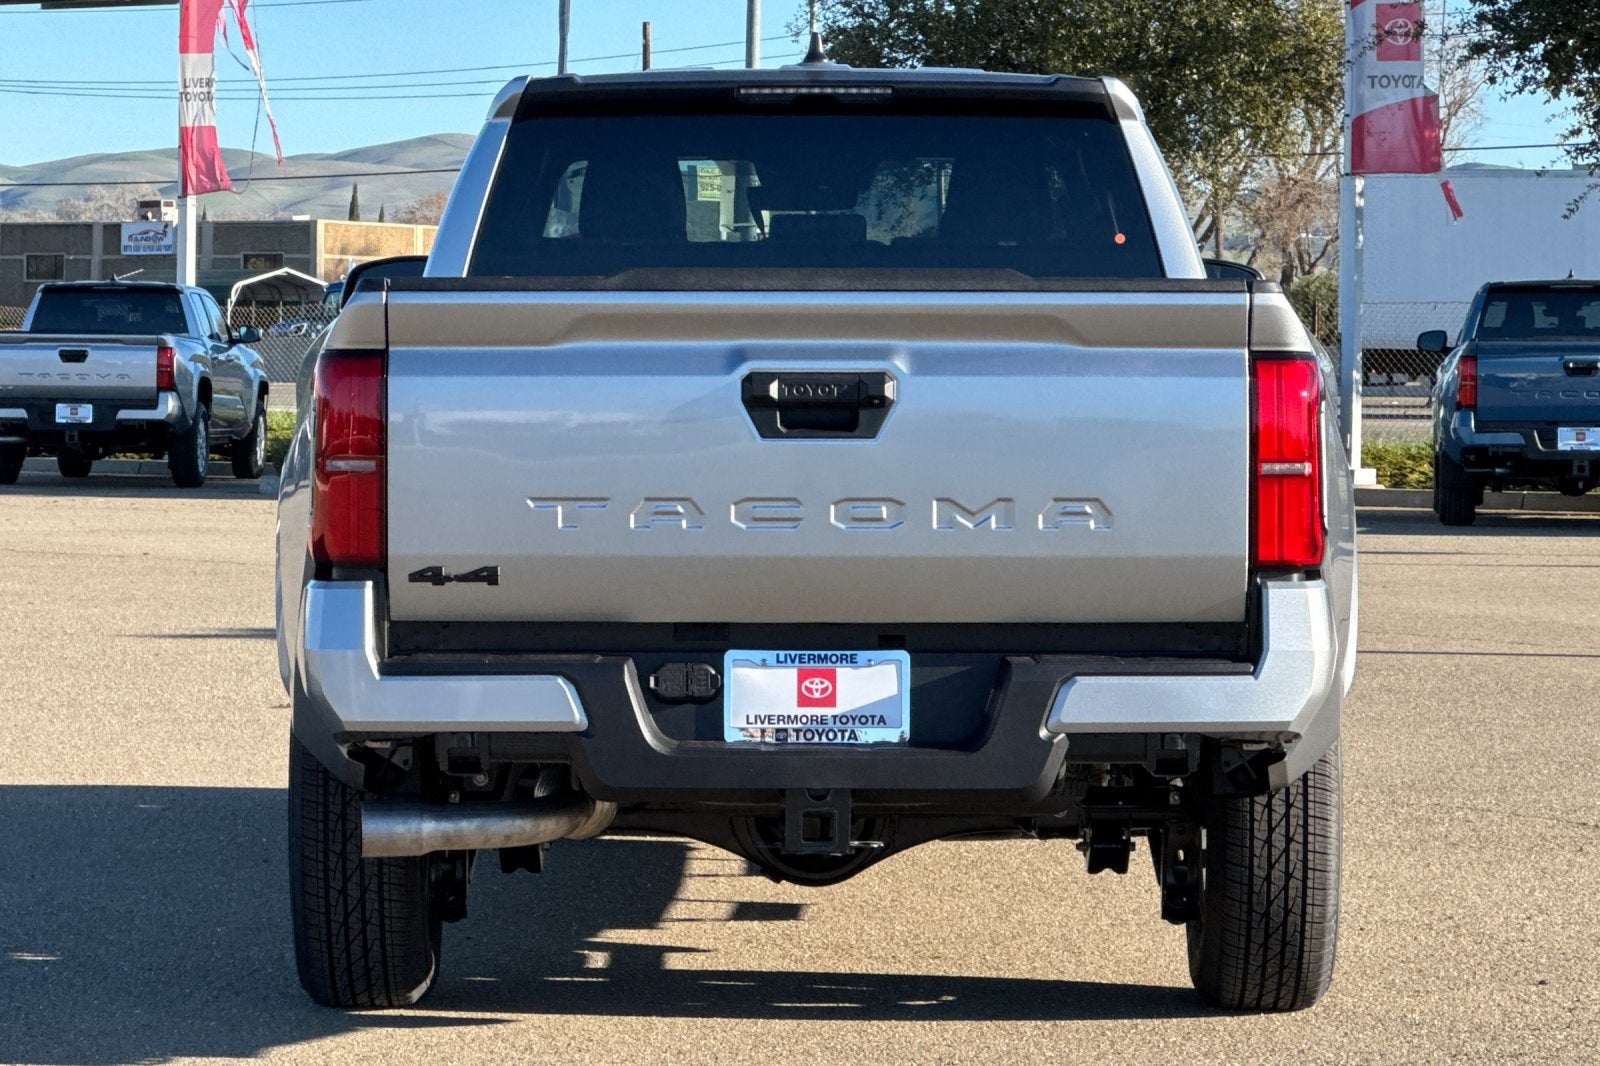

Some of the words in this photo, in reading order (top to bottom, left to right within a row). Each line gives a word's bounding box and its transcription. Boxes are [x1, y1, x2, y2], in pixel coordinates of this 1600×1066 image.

[526, 497, 1113, 531] TACOMA
[776, 653, 858, 665] LIVERMORE
[746, 714, 828, 726] LIVERMORE
[831, 714, 887, 726] TOYOTA
[794, 729, 859, 742] TOYOTA
